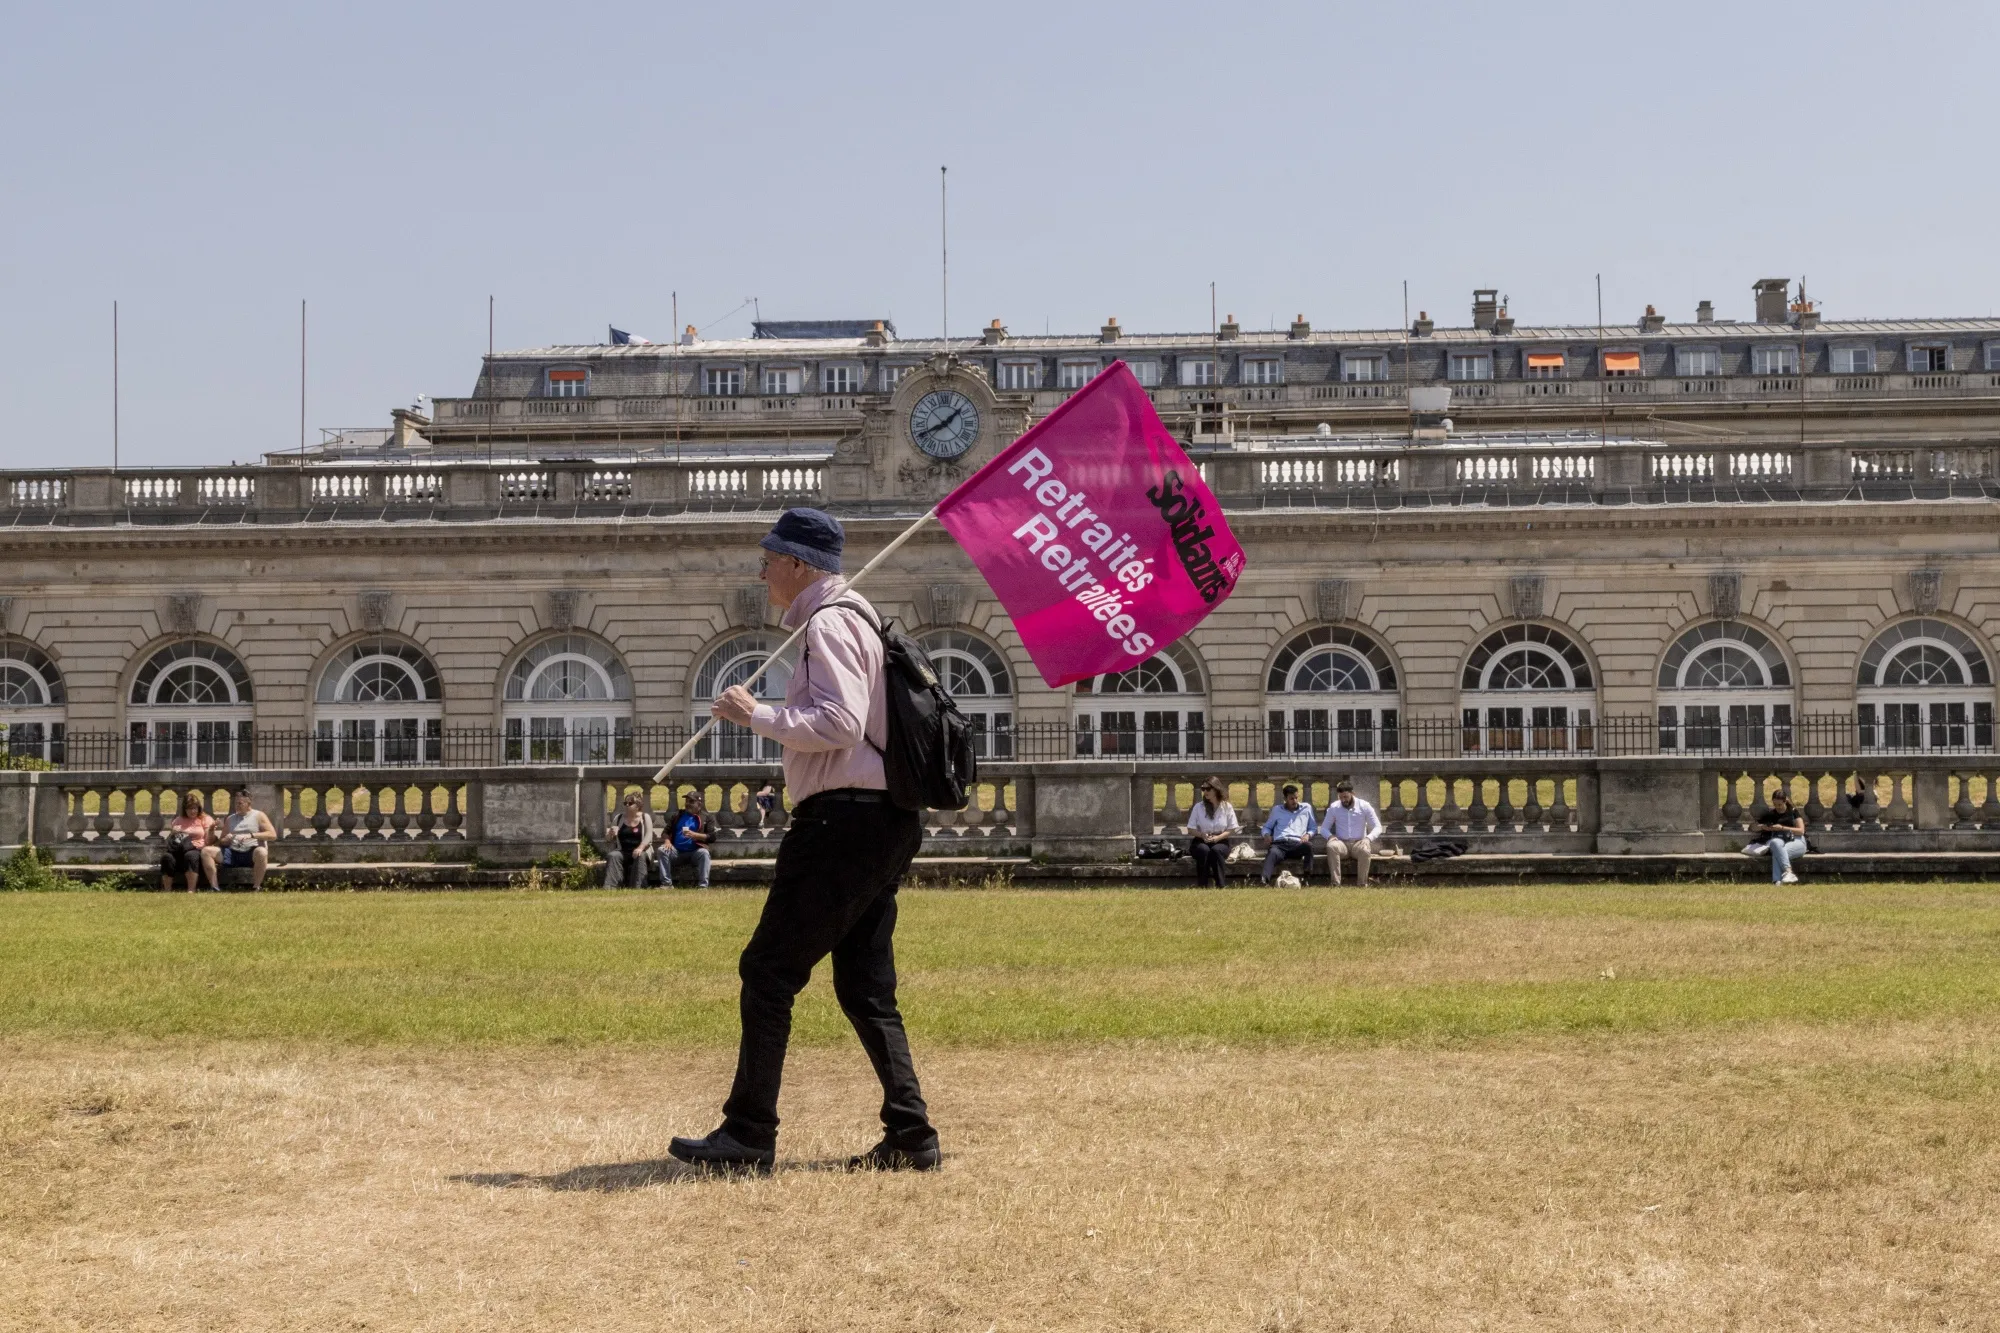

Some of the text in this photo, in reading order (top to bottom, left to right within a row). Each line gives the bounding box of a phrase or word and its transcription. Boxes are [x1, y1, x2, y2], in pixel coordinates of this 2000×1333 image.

[1007, 447, 1154, 593] Retraités
[1012, 512, 1155, 656] Retraitées
[1145, 470, 1229, 603] Solidairs
